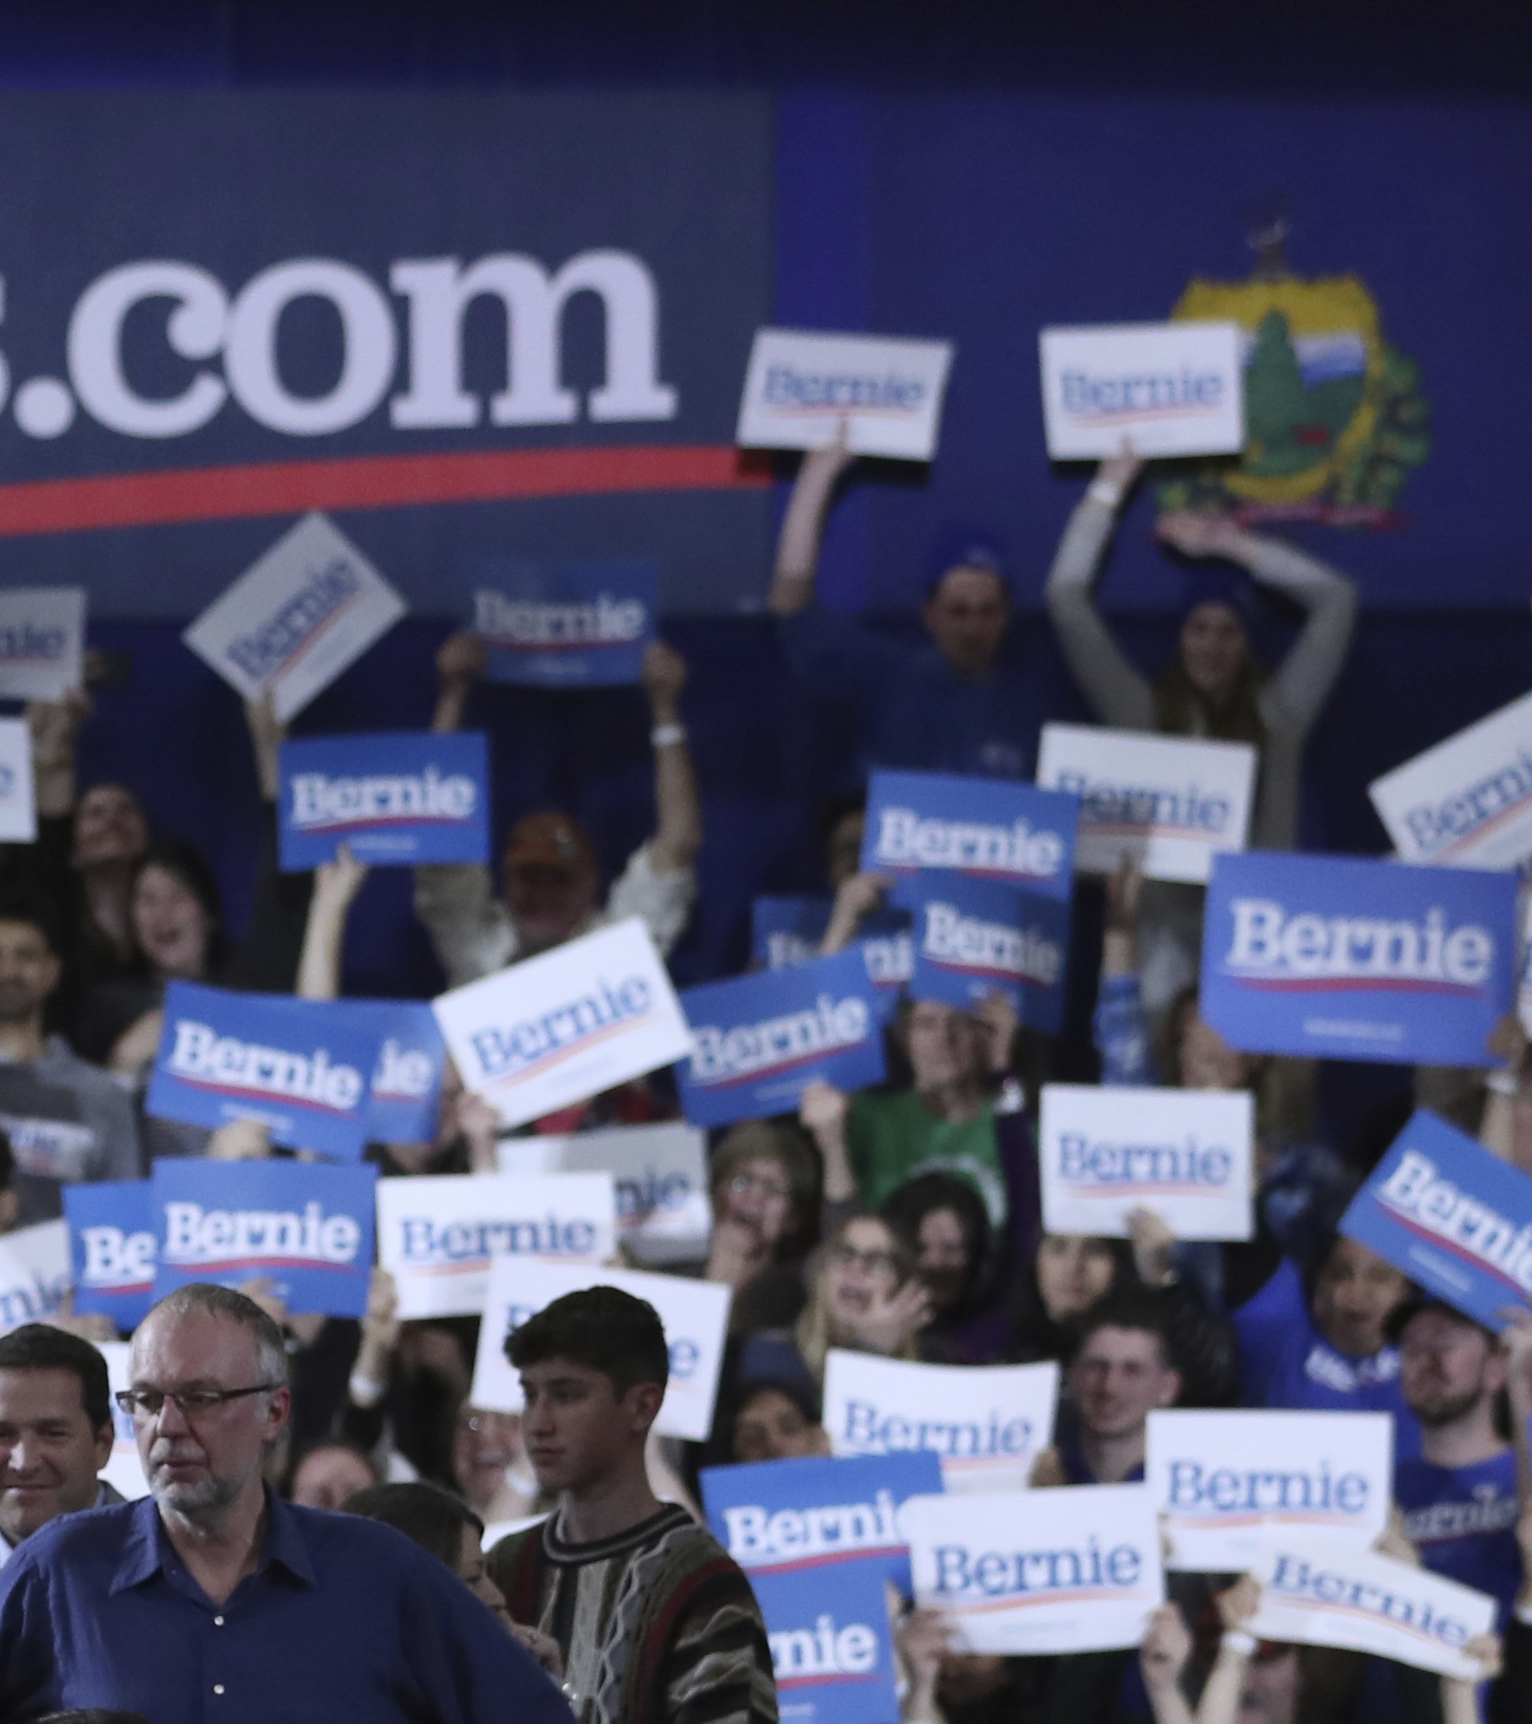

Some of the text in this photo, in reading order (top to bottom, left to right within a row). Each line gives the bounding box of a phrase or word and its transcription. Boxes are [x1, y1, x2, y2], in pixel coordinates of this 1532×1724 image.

[226, 558, 354, 681] Bernie
[290, 767, 478, 821] Bernie
[877, 808, 1063, 876] Bernie
[1232, 898, 1493, 984] Bernie
[469, 972, 652, 1077] Bernie
[691, 991, 869, 1083] Bernie
[175, 1021, 362, 1110] Bernie
[1058, 1133, 1232, 1185] Bernie
[165, 1200, 360, 1264] Bernie
[401, 1211, 595, 1259] Bernie
[841, 1400, 1032, 1455] Bernie
[1168, 1458, 1368, 1516] Bernie
[934, 1536, 1140, 1594] Bernie
[1272, 1554, 1469, 1648] Bernie
